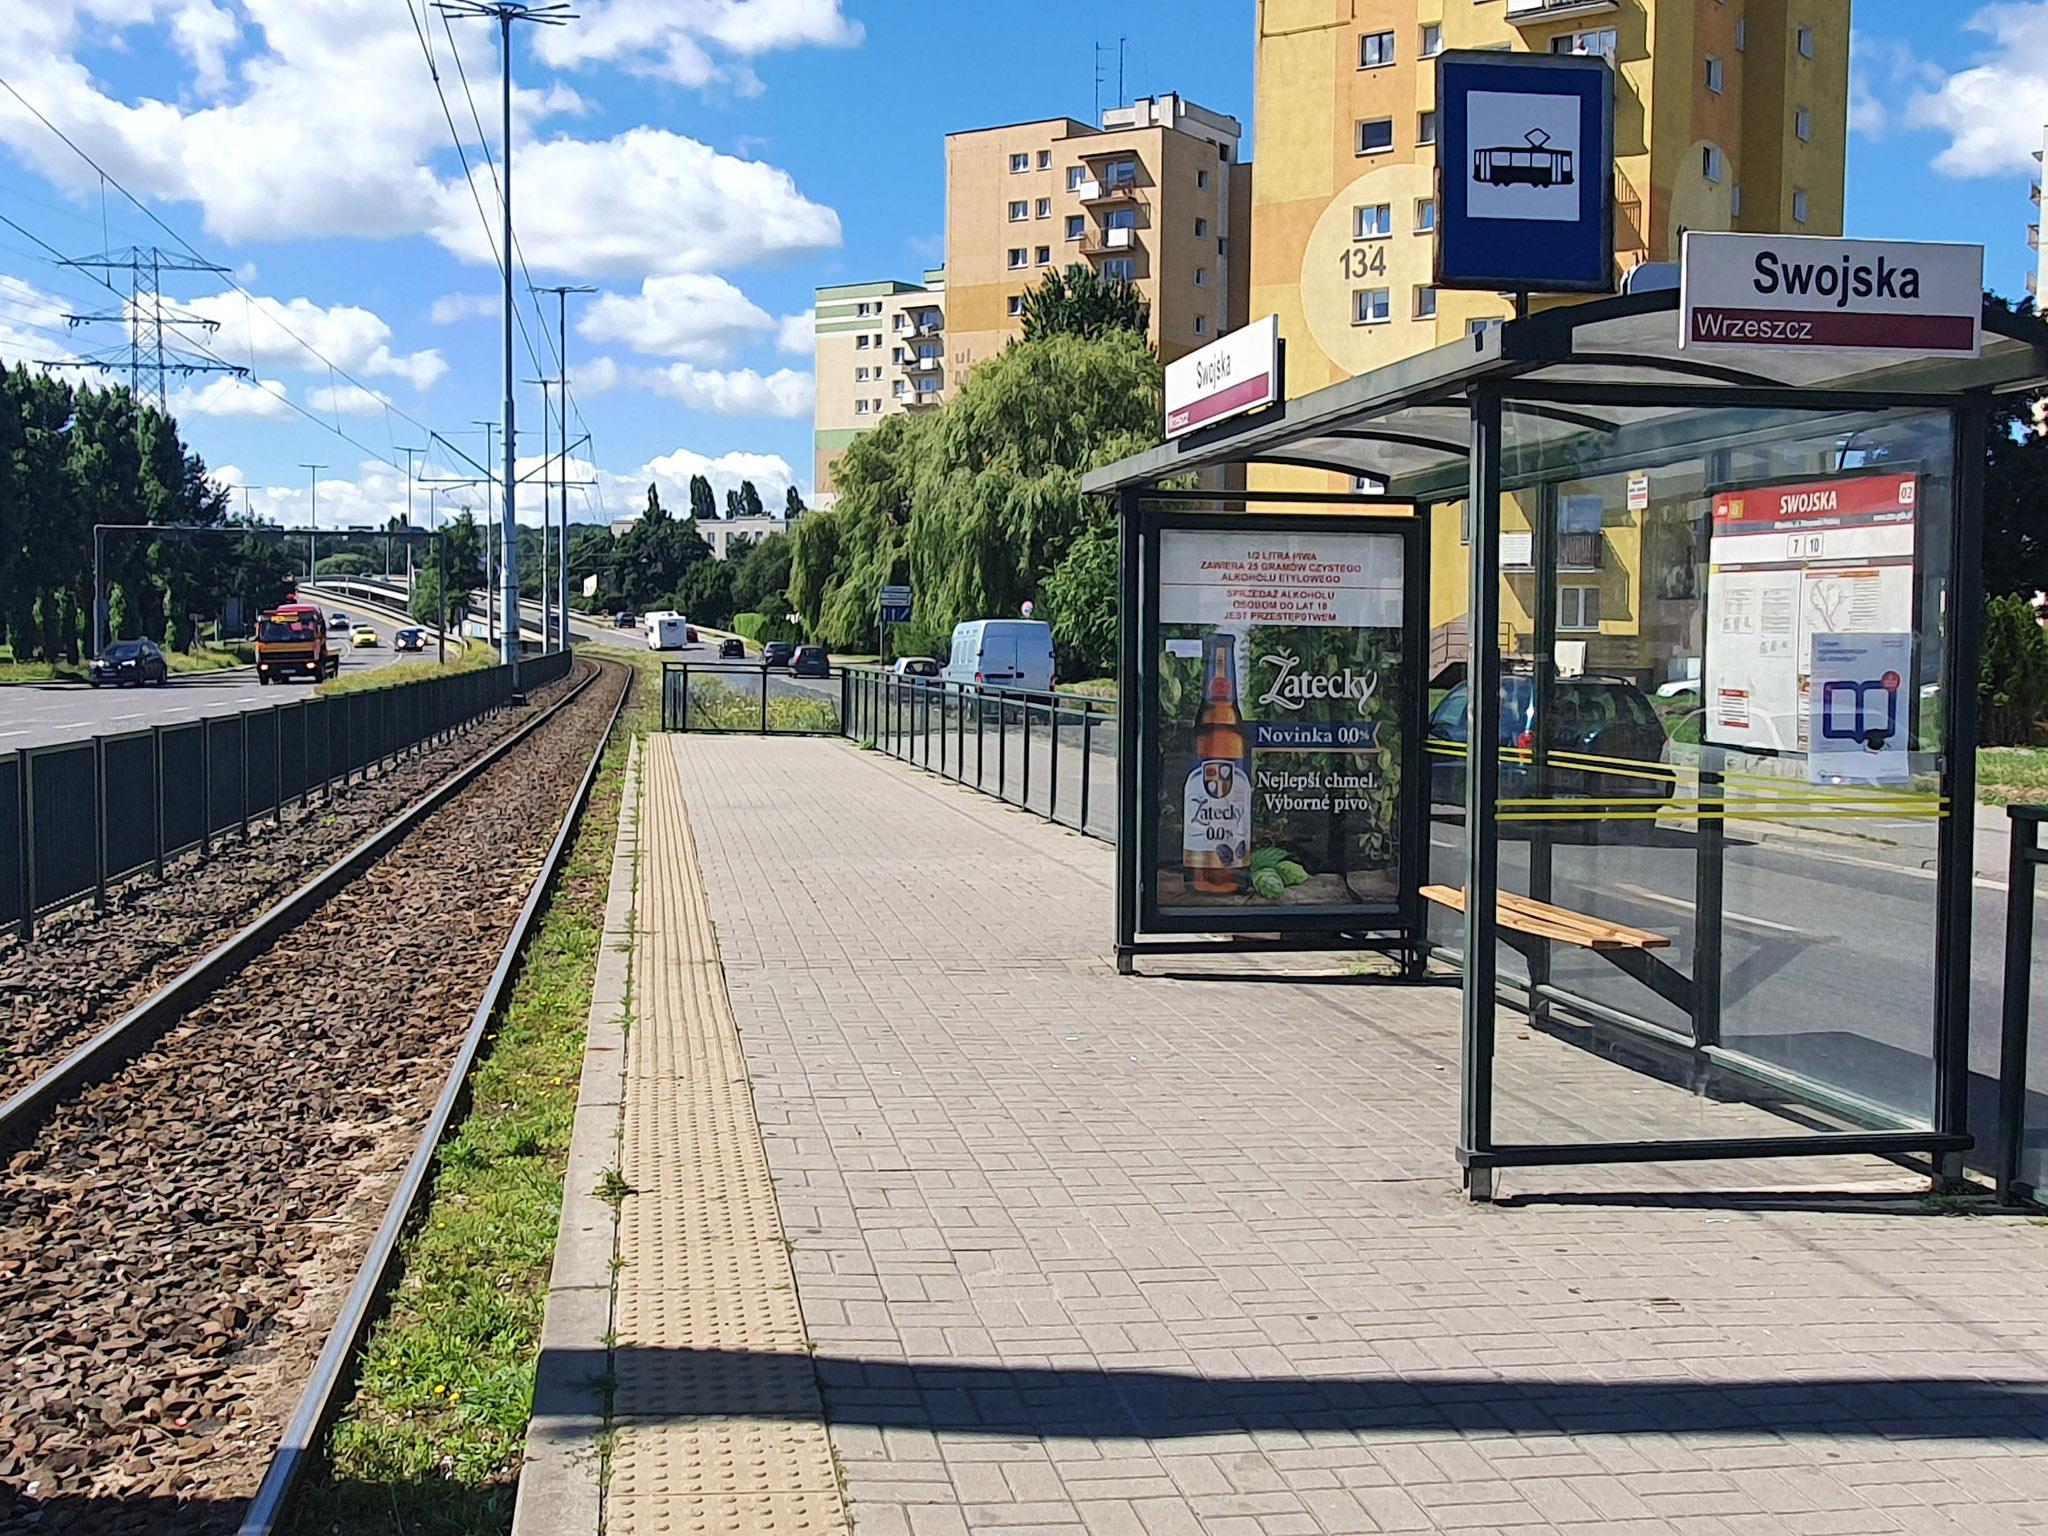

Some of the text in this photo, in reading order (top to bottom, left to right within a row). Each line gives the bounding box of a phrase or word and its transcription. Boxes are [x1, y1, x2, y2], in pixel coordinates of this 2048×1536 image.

[1339, 246, 1387, 280] 134
[1753, 251, 1920, 308] Swojska
[1697, 313, 1812, 340] Wrzeszcz
[955, 348, 976, 364] ul.
[1196, 350, 1231, 390] Swojska
[1779, 486, 1913, 515] SWOJSKA 02
[1793, 538, 1820, 554] 7 10
[1262, 552, 1290, 561] LITRA
[1200, 561, 1362, 573] ZAWIERA 25 GRAMÓW CZYSTEGO
[1221, 573, 1341, 583] ALKOHOLU ETYLOWEGO
[1281, 590, 1335, 600] ALKOHOLU
[1232, 601, 1327, 611] OSOBOM DO LAT 18
[1224, 611, 1337, 622] JEST PRZESTĘPSTWEM
[1258, 726, 1333, 743] Novinka
[1257, 771, 1378, 791] Nejlepší chmel.
[1264, 793, 1331, 814] Výborné
